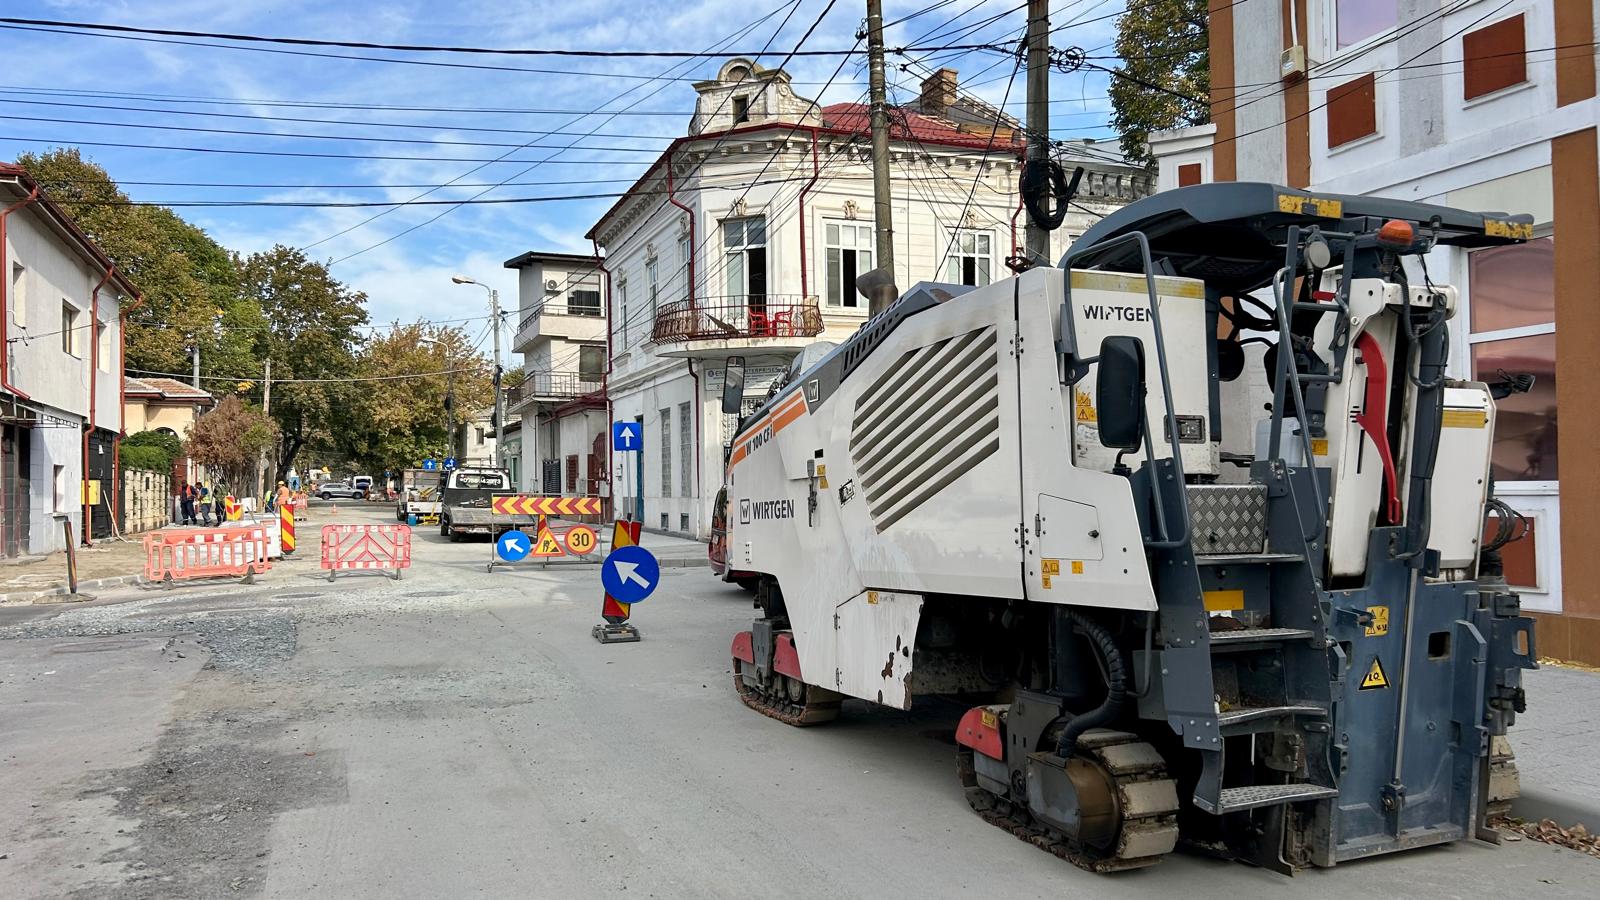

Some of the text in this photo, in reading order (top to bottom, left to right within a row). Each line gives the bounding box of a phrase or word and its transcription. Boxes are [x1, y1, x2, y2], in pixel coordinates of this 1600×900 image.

[746, 440, 752, 456] W
[753, 433, 763, 451] 100
[752, 499, 794, 519] WIRTGEN
[572, 533, 589, 547] 30
